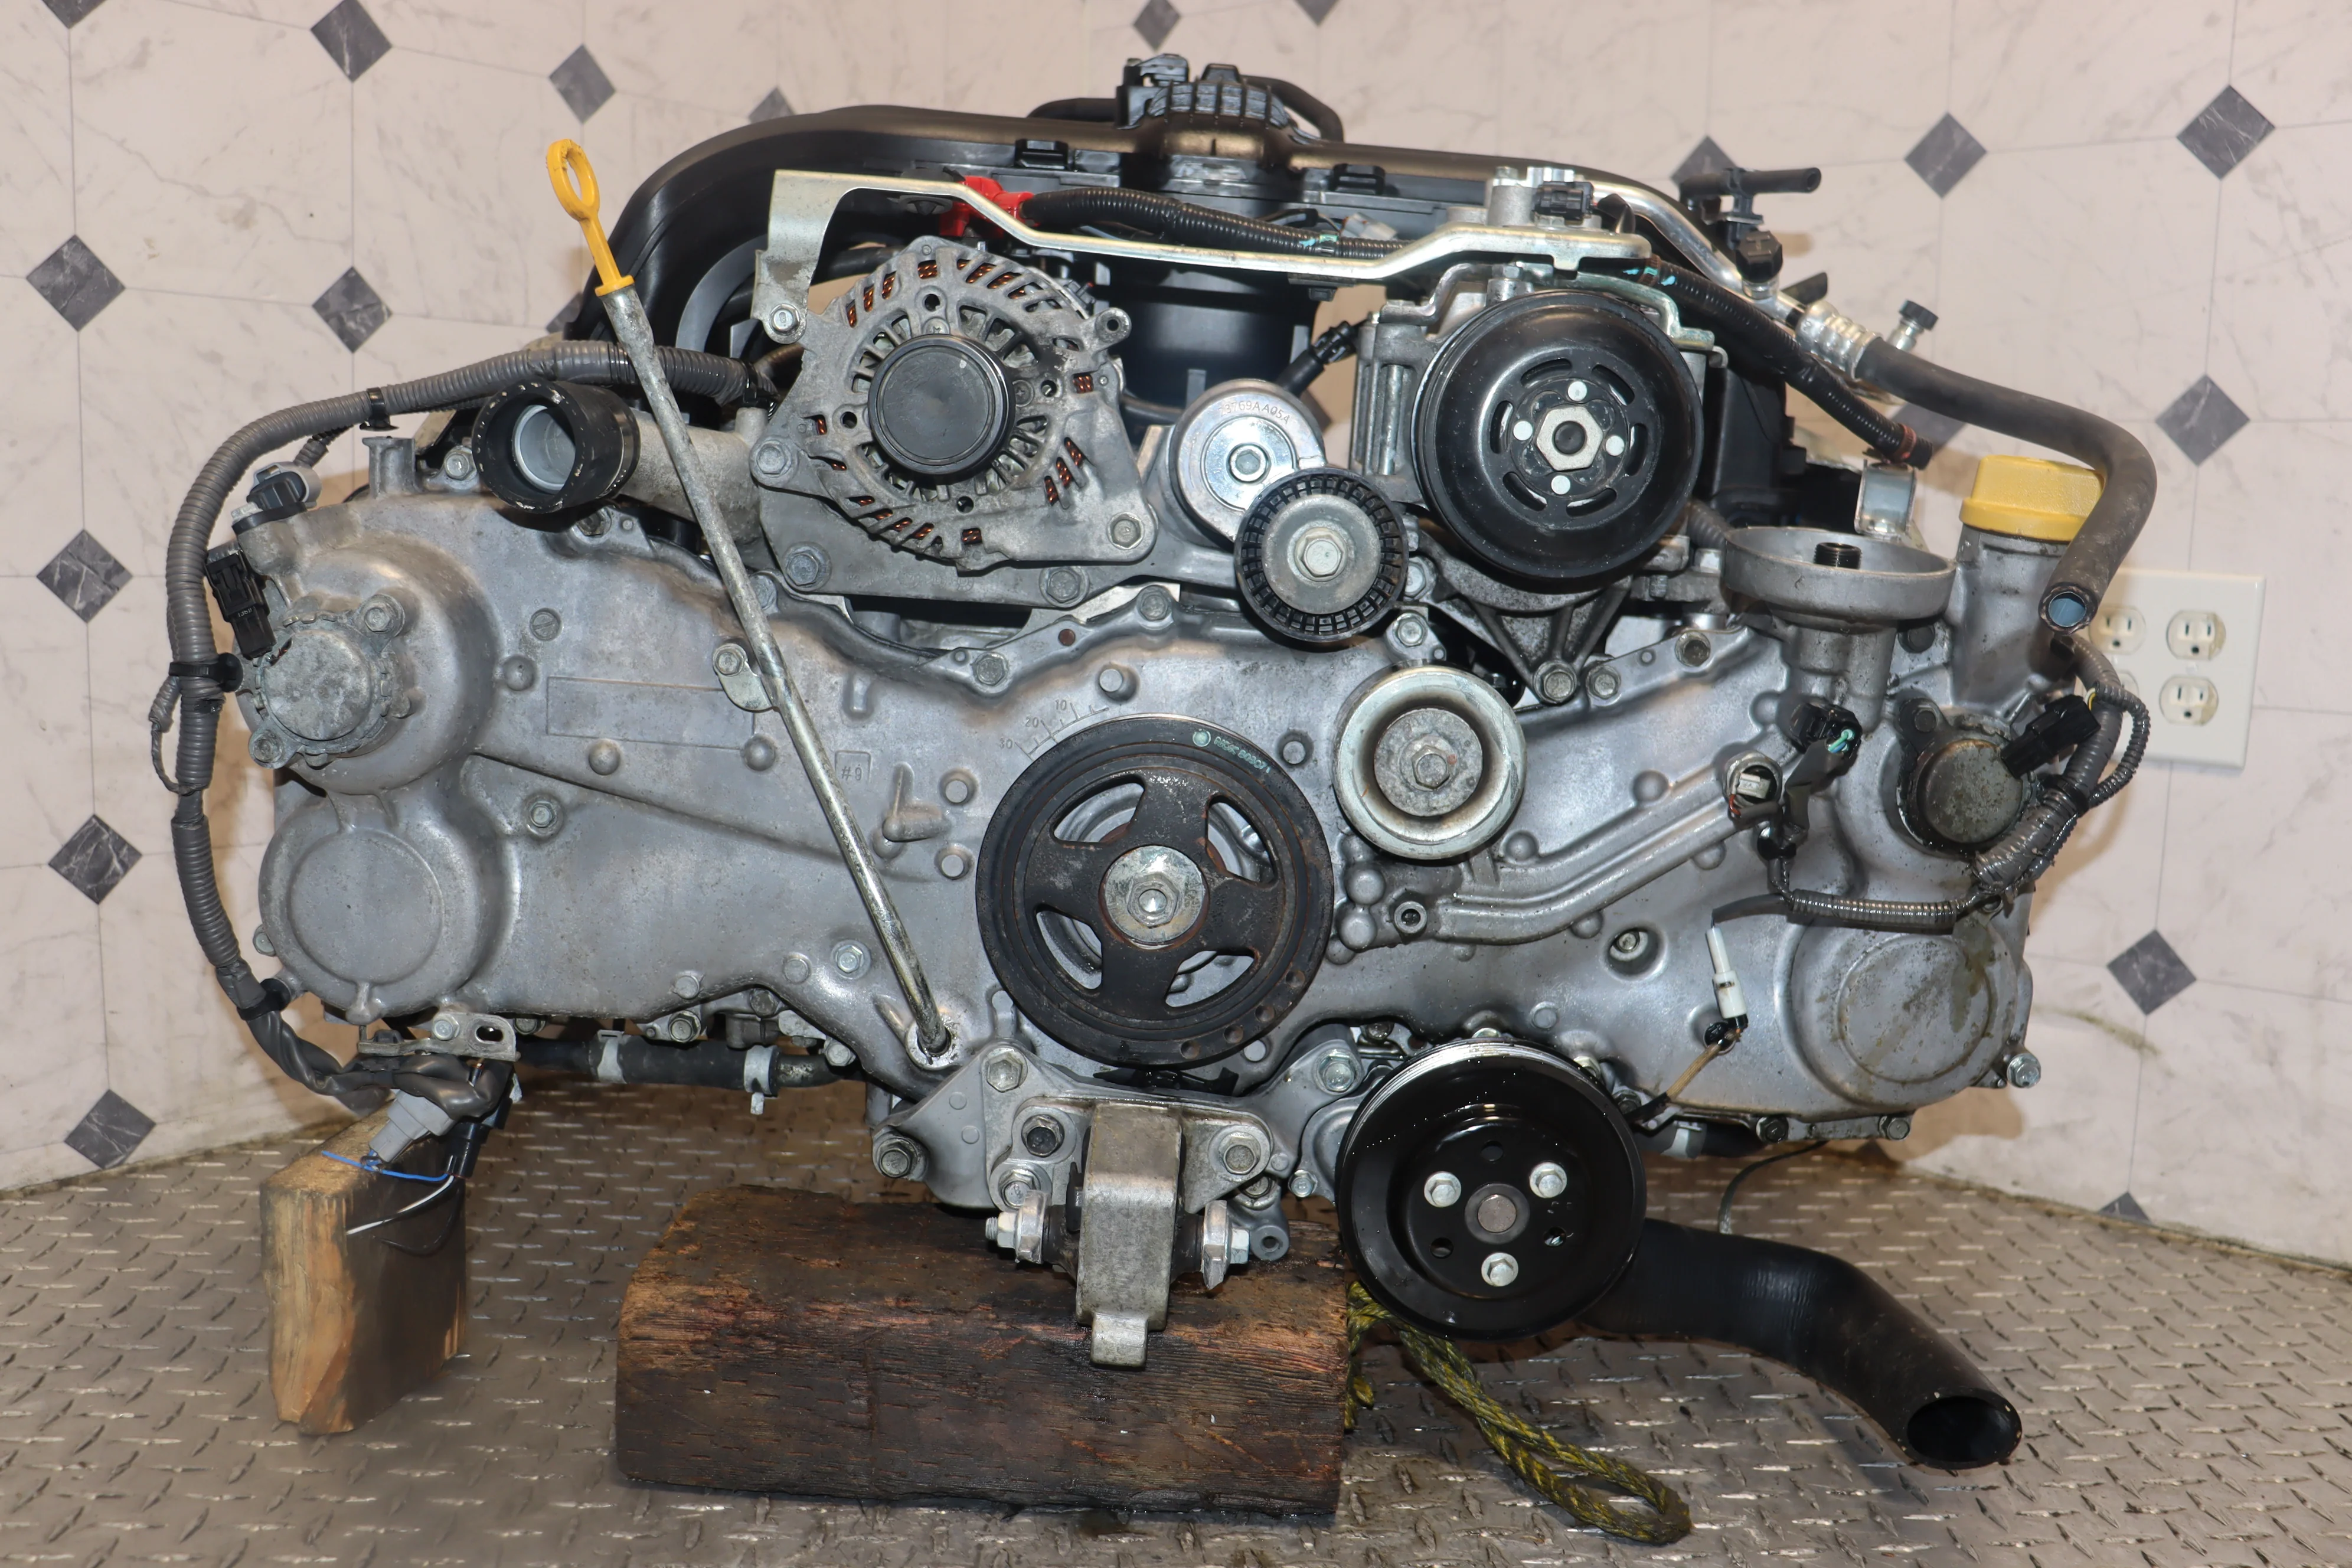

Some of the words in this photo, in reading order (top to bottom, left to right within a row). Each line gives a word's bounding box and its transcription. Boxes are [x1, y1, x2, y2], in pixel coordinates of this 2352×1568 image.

[1055, 699, 1067, 711] 10
[1025, 716, 1040, 728] 20
[999, 737, 1014, 749] 30
